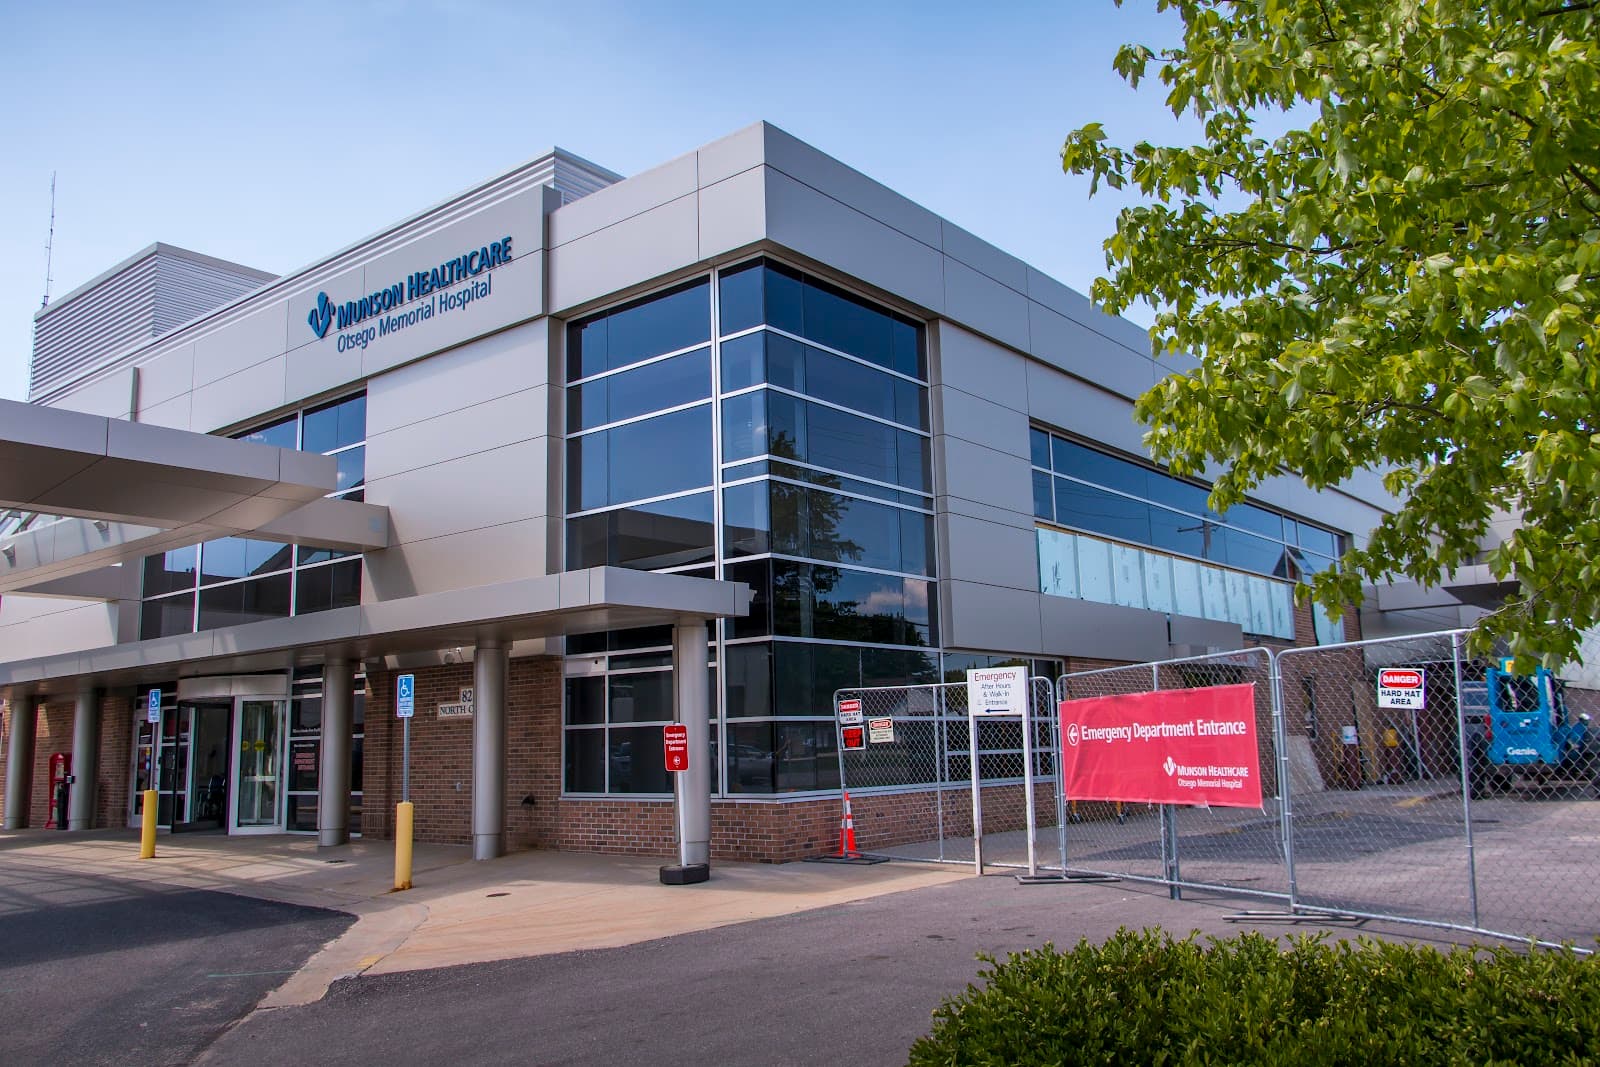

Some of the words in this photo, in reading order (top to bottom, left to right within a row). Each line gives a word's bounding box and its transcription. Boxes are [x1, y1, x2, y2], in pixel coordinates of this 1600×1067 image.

[337, 282, 404, 329] MUNSON
[407, 236, 512, 300] HEALTHCARE
[338, 327, 376, 352] Otsego
[379, 296, 435, 337] Memorial
[439, 273, 492, 314] Hospital
[974, 672, 1017, 682] Emergency
[1382, 675, 1419, 684] DANGER
[1405, 690, 1421, 698] HAT
[440, 705, 466, 714] NORTH
[1081, 725, 1132, 743] Emergency
[1134, 720, 1195, 742] Department
[1197, 719, 1246, 736] Entrance
[1507, 747, 1537, 756] Genie
[1177, 765, 1207, 777] MUNSON
[1208, 765, 1249, 777] HEALTHCARE
[1197, 779, 1221, 788] Memorial
[1221, 779, 1243, 790] Hospital
